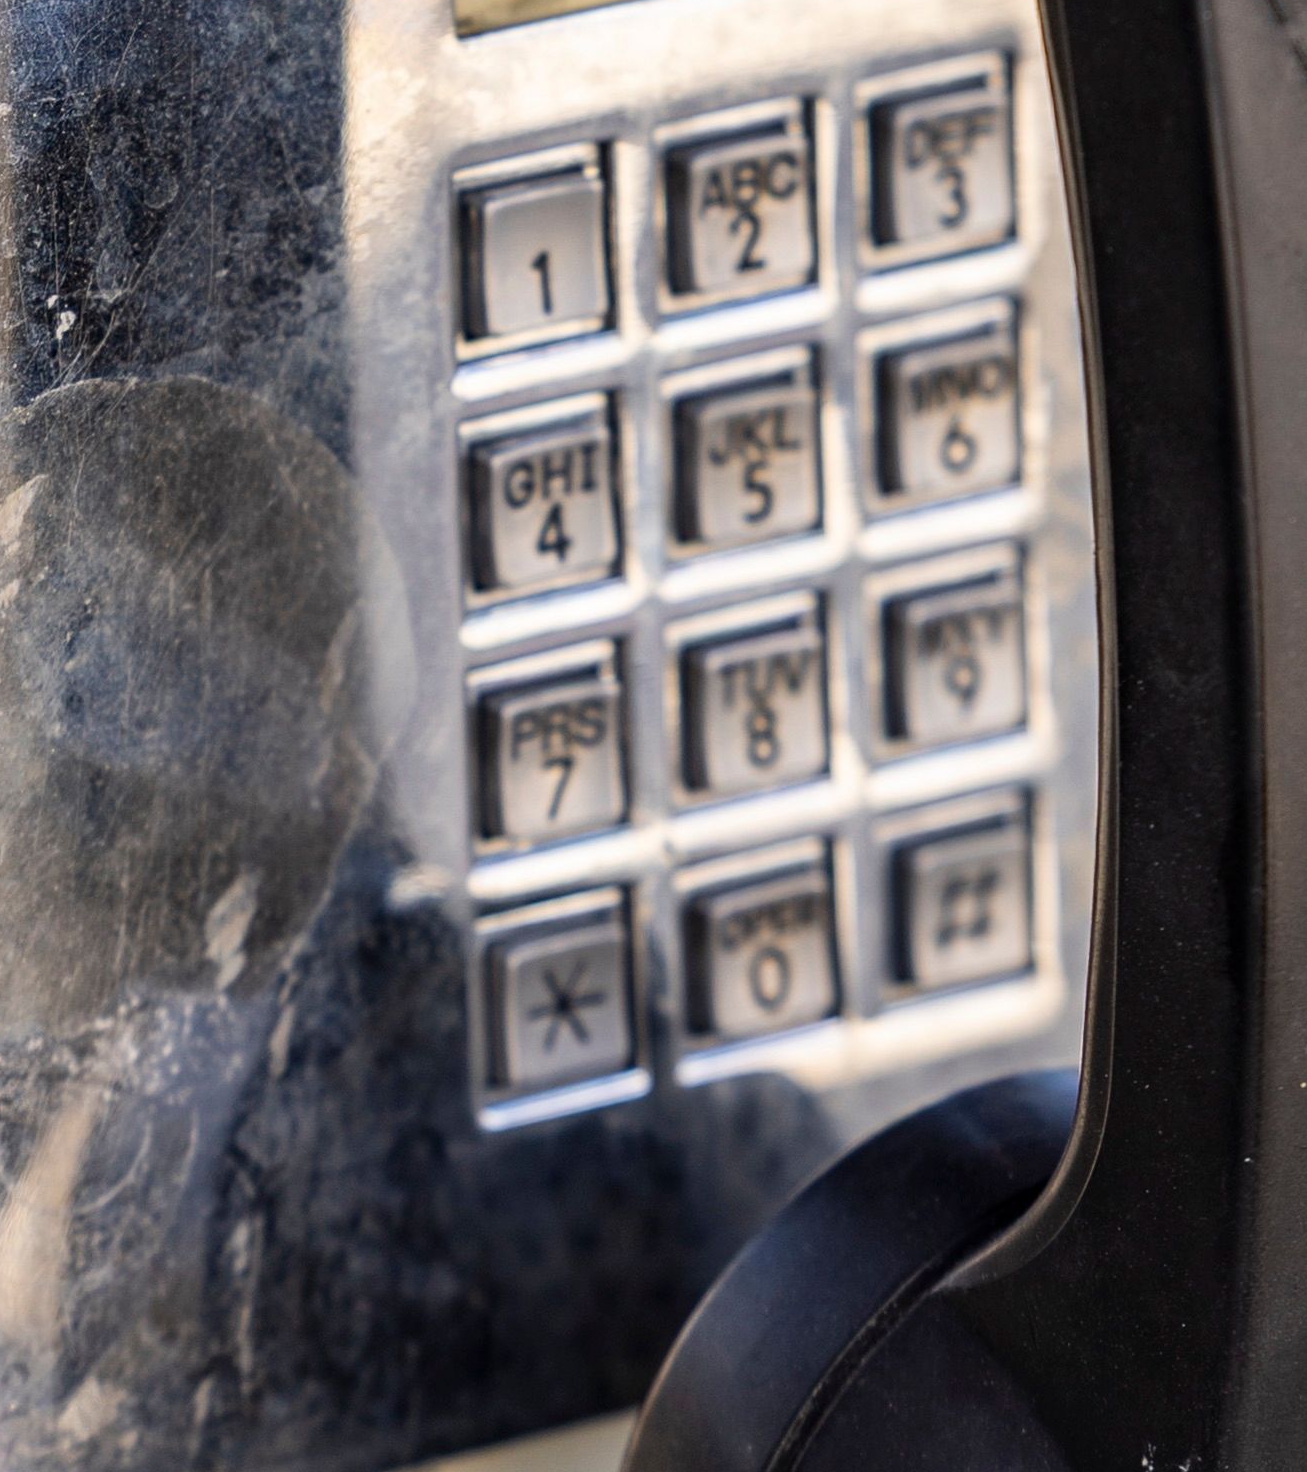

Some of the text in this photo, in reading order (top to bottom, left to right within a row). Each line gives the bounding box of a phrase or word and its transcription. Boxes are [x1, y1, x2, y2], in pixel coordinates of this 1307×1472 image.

[902, 111, 995, 172] DEF
[700, 156, 800, 219] ABC
[936, 166, 971, 229] 3
[727, 212, 767, 272] 2
[529, 250, 553, 316] 1
[708, 407, 801, 466] JKL
[941, 414, 979, 475] 6
[502, 443, 601, 509] GHI
[743, 460, 775, 525] 5
[536, 502, 572, 563] 4
[718, 648, 812, 709] TUV
[943, 654, 983, 714] 9
[508, 698, 609, 760] PRS
[745, 705, 780, 768] 8
[542, 756, 577, 822] 7
